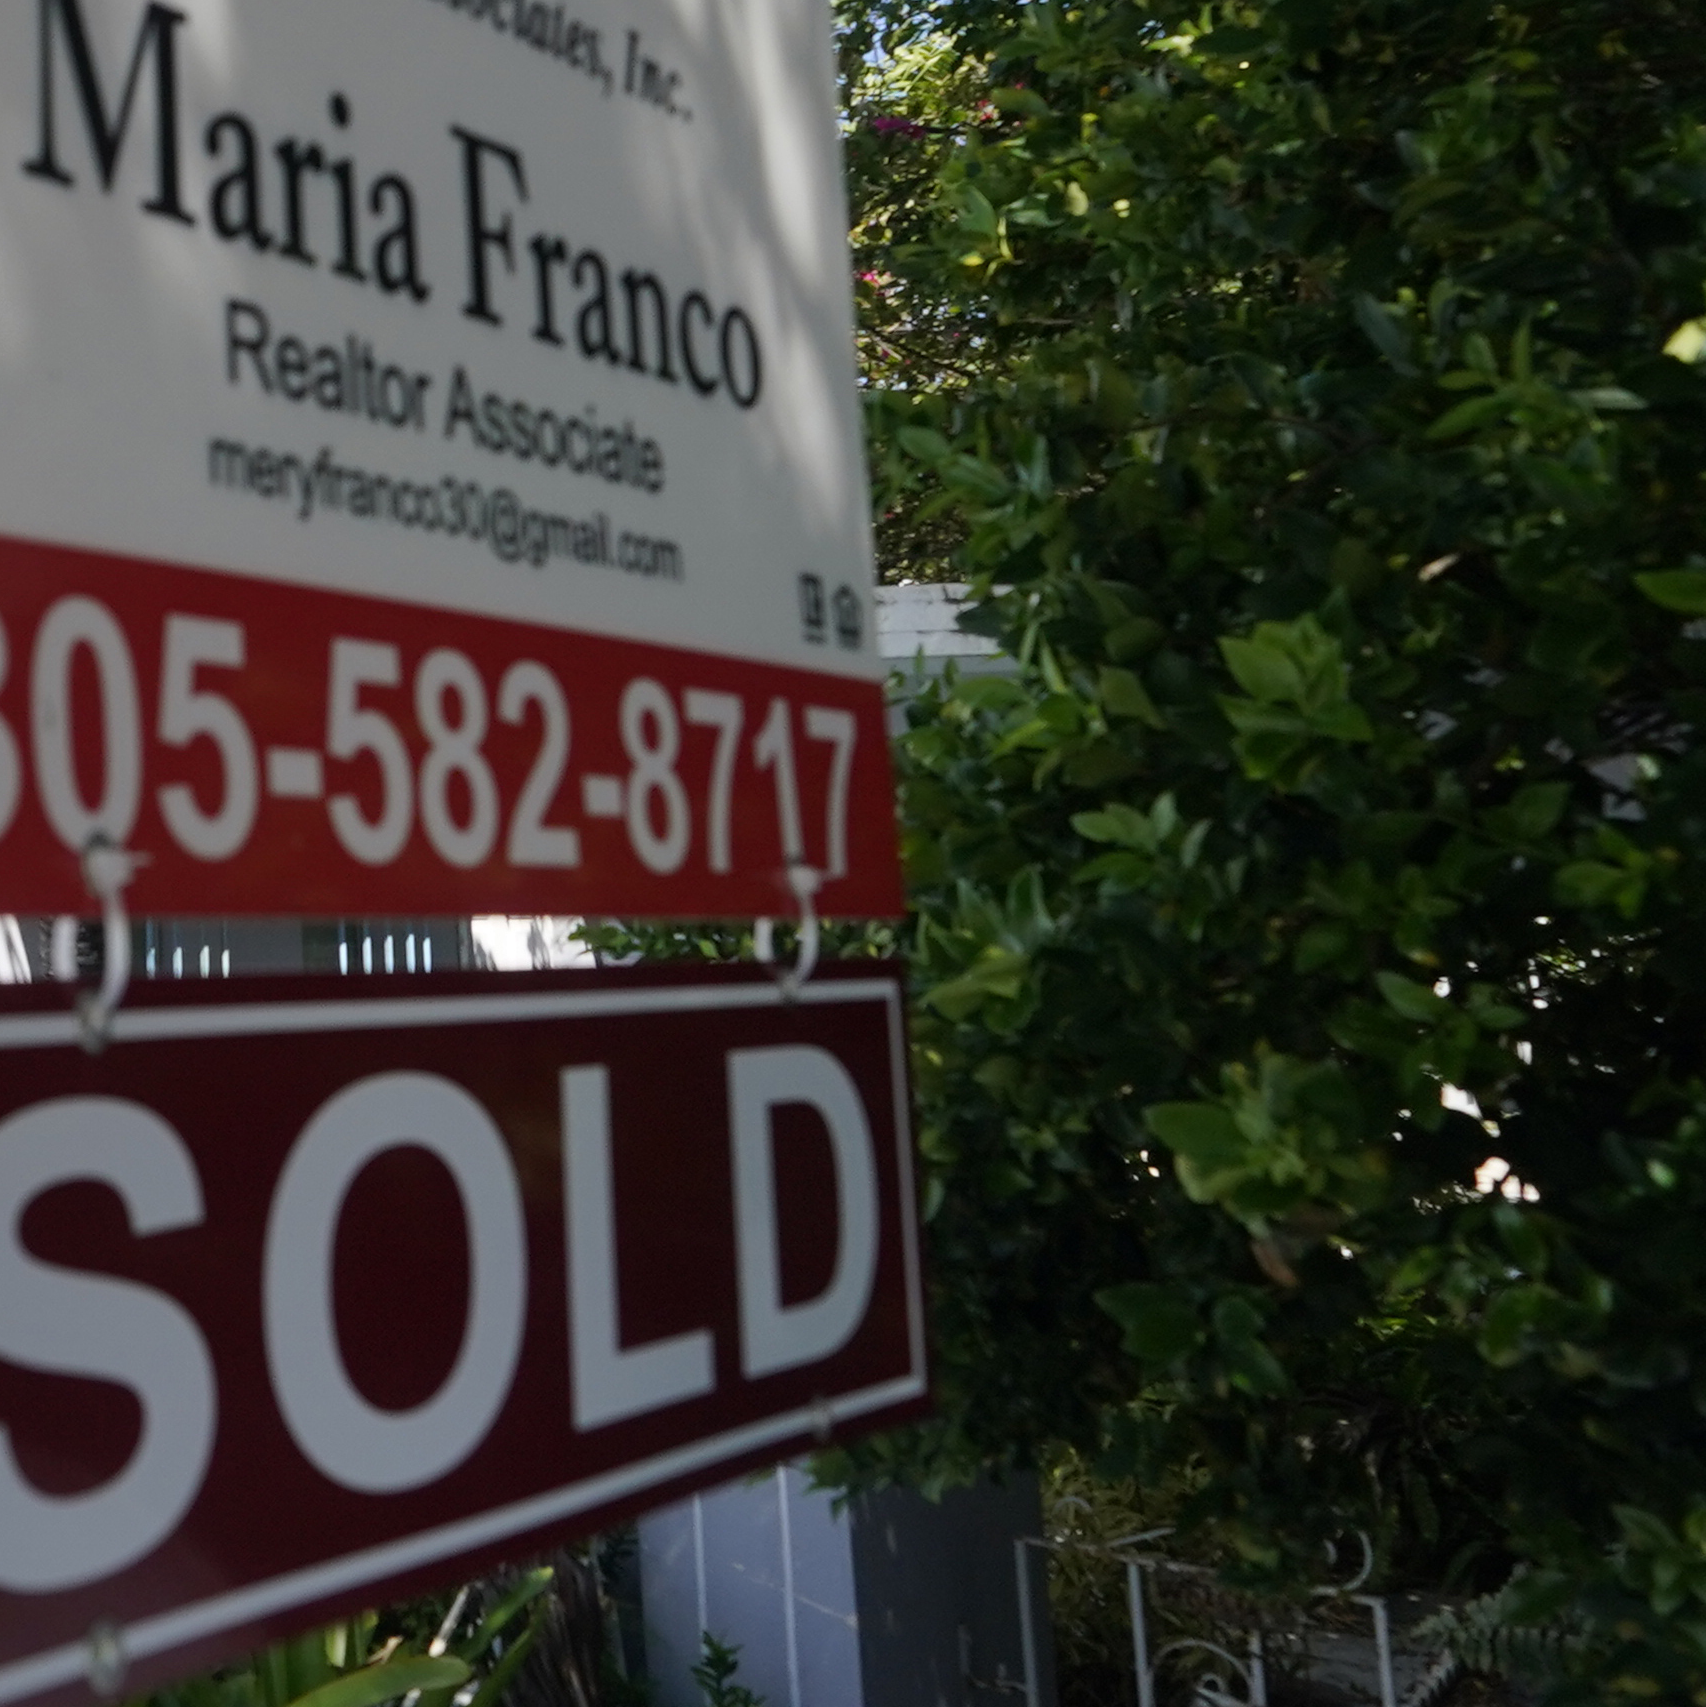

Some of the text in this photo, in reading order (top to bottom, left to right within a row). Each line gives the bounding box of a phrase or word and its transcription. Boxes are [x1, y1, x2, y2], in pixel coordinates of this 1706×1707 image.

[449, 123, 763, 410] Franco
[224, 297, 665, 494] Realtor Associate
